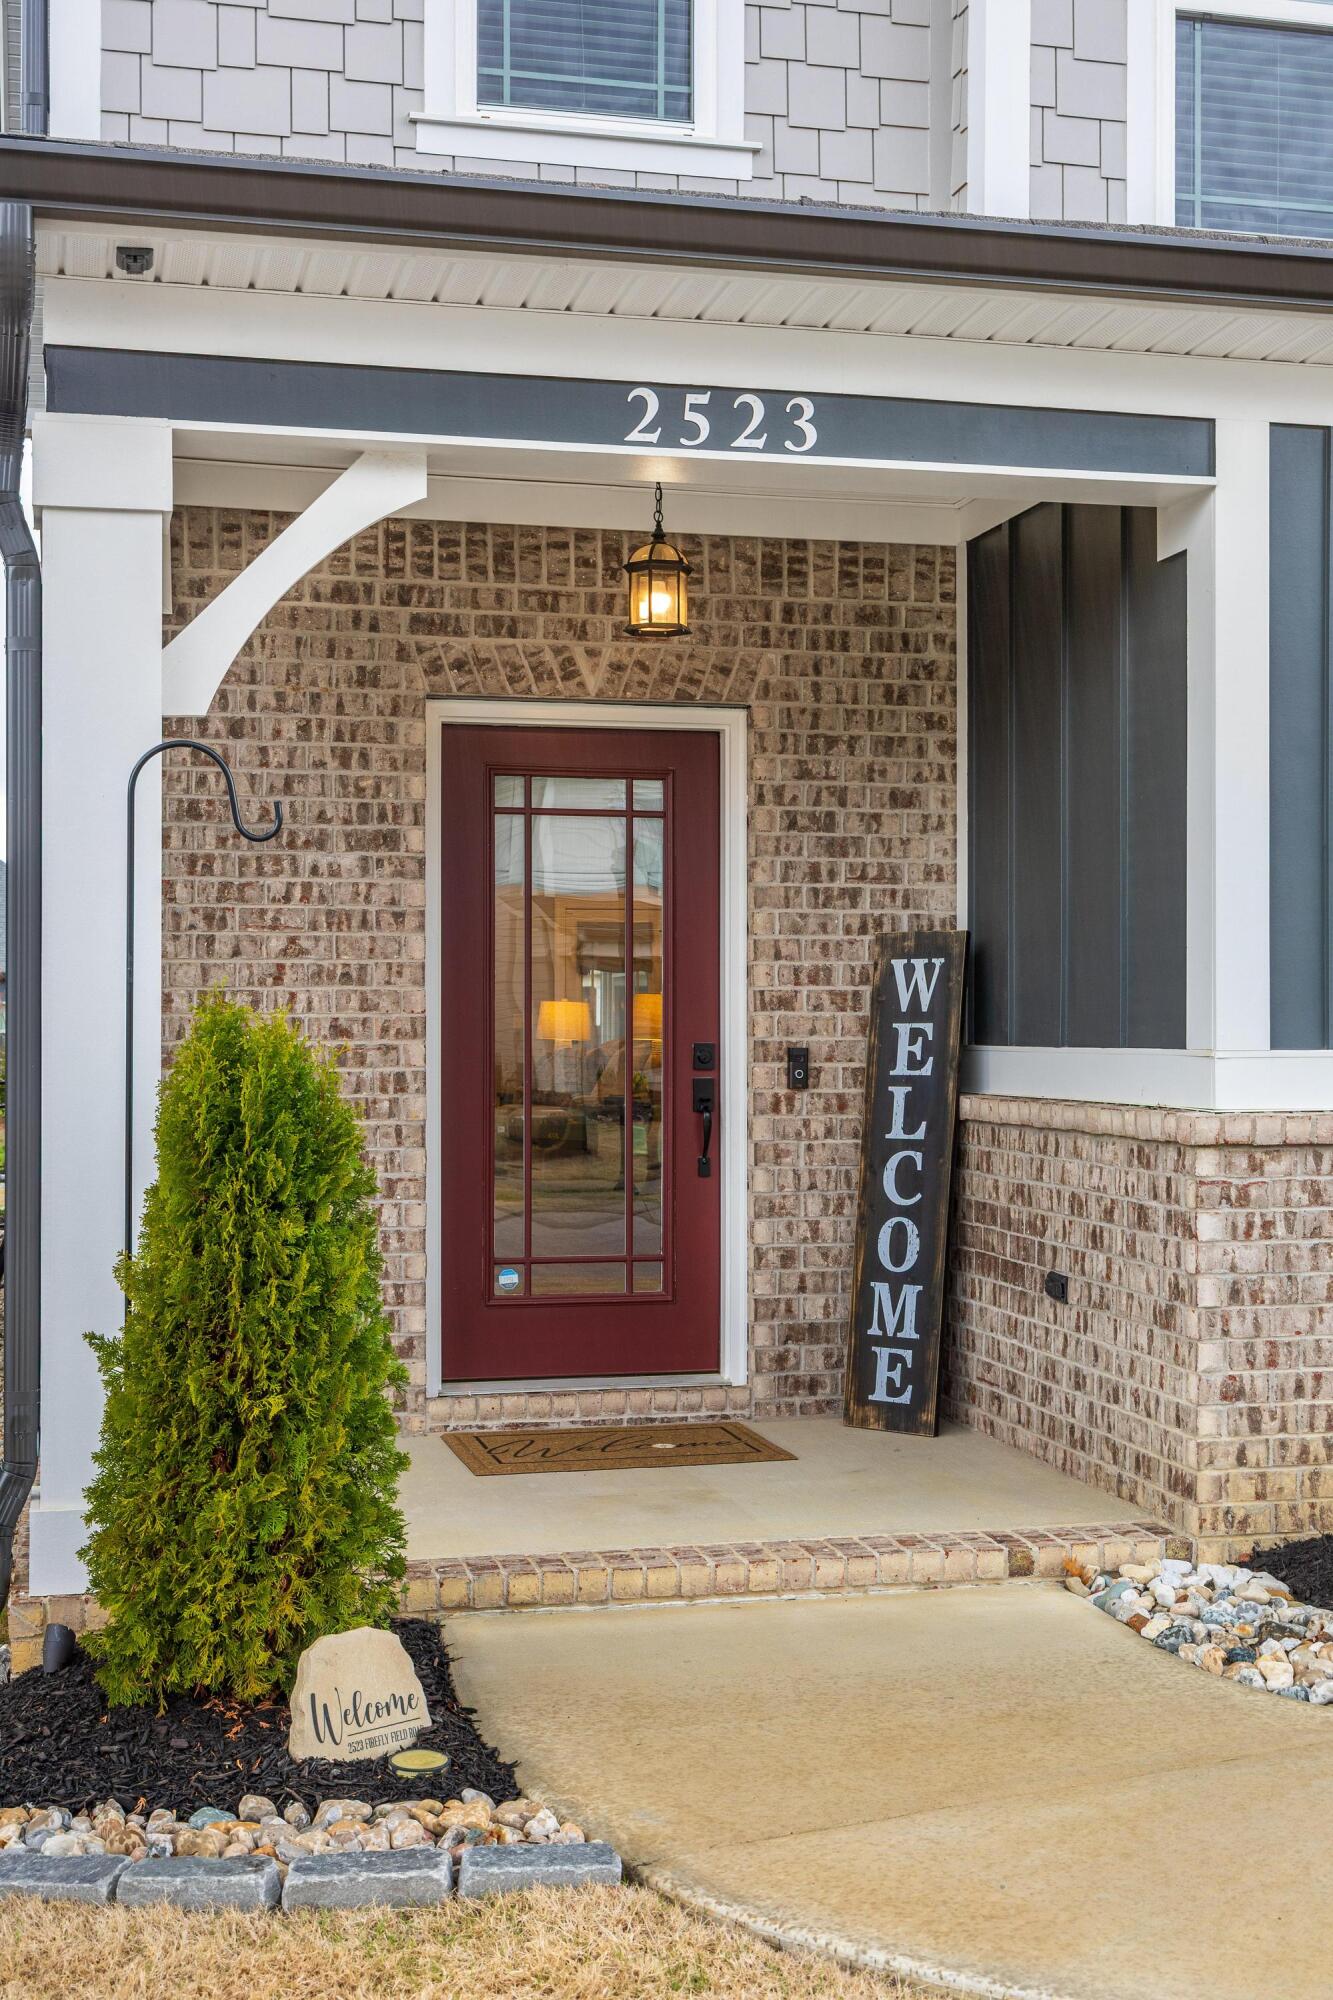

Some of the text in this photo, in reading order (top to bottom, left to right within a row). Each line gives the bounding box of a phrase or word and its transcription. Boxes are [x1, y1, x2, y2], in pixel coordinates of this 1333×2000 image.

[623, 387, 818, 452] 2523
[867, 958, 945, 1405] WELCOME
[486, 1431, 749, 1458] Welcme
[310, 1687, 420, 1746] Welcome
[347, 1724, 424, 1754] 2523 FIREFLY FIELD ROA
